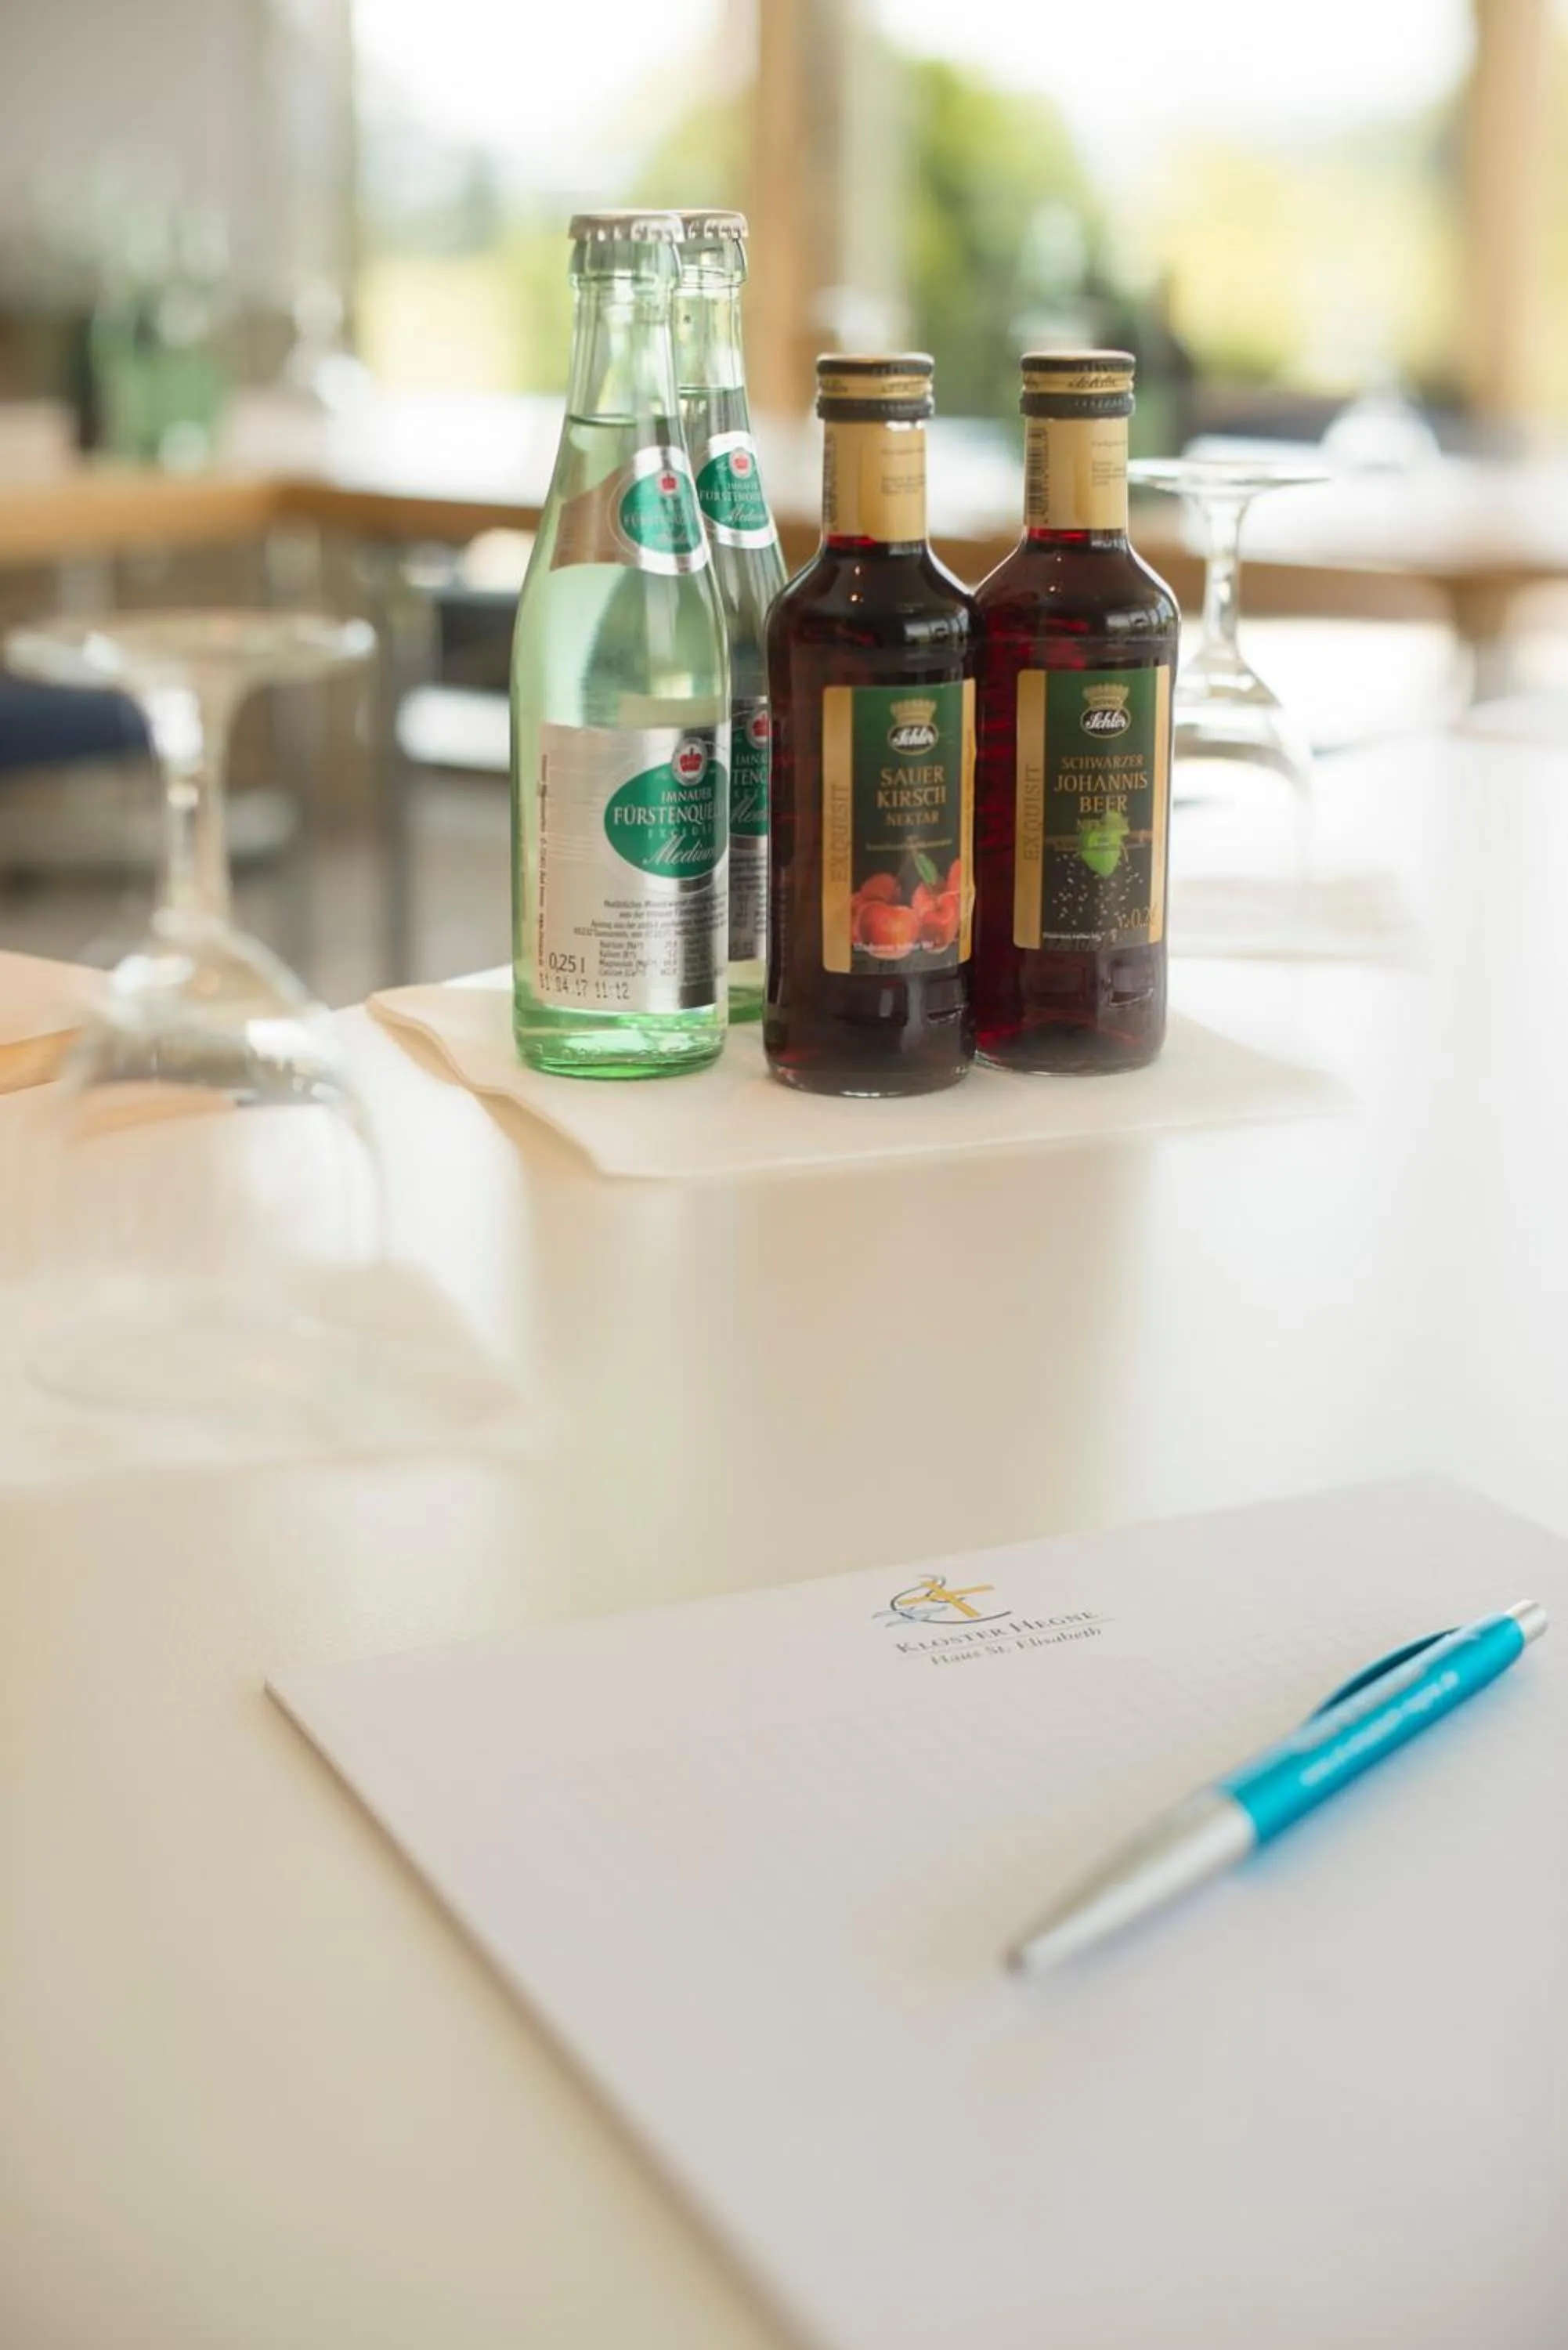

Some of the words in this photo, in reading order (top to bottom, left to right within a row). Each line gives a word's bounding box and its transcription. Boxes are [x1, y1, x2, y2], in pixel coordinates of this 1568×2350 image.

[1061, 754, 1143, 771] SCHWARZER
[880, 765, 945, 787] SAUER
[1053, 772, 1148, 793] JOHANNIS
[661, 787, 713, 804] IMNAUER
[876, 786, 946, 809] KIRSCH
[1079, 794, 1129, 814] BEER
